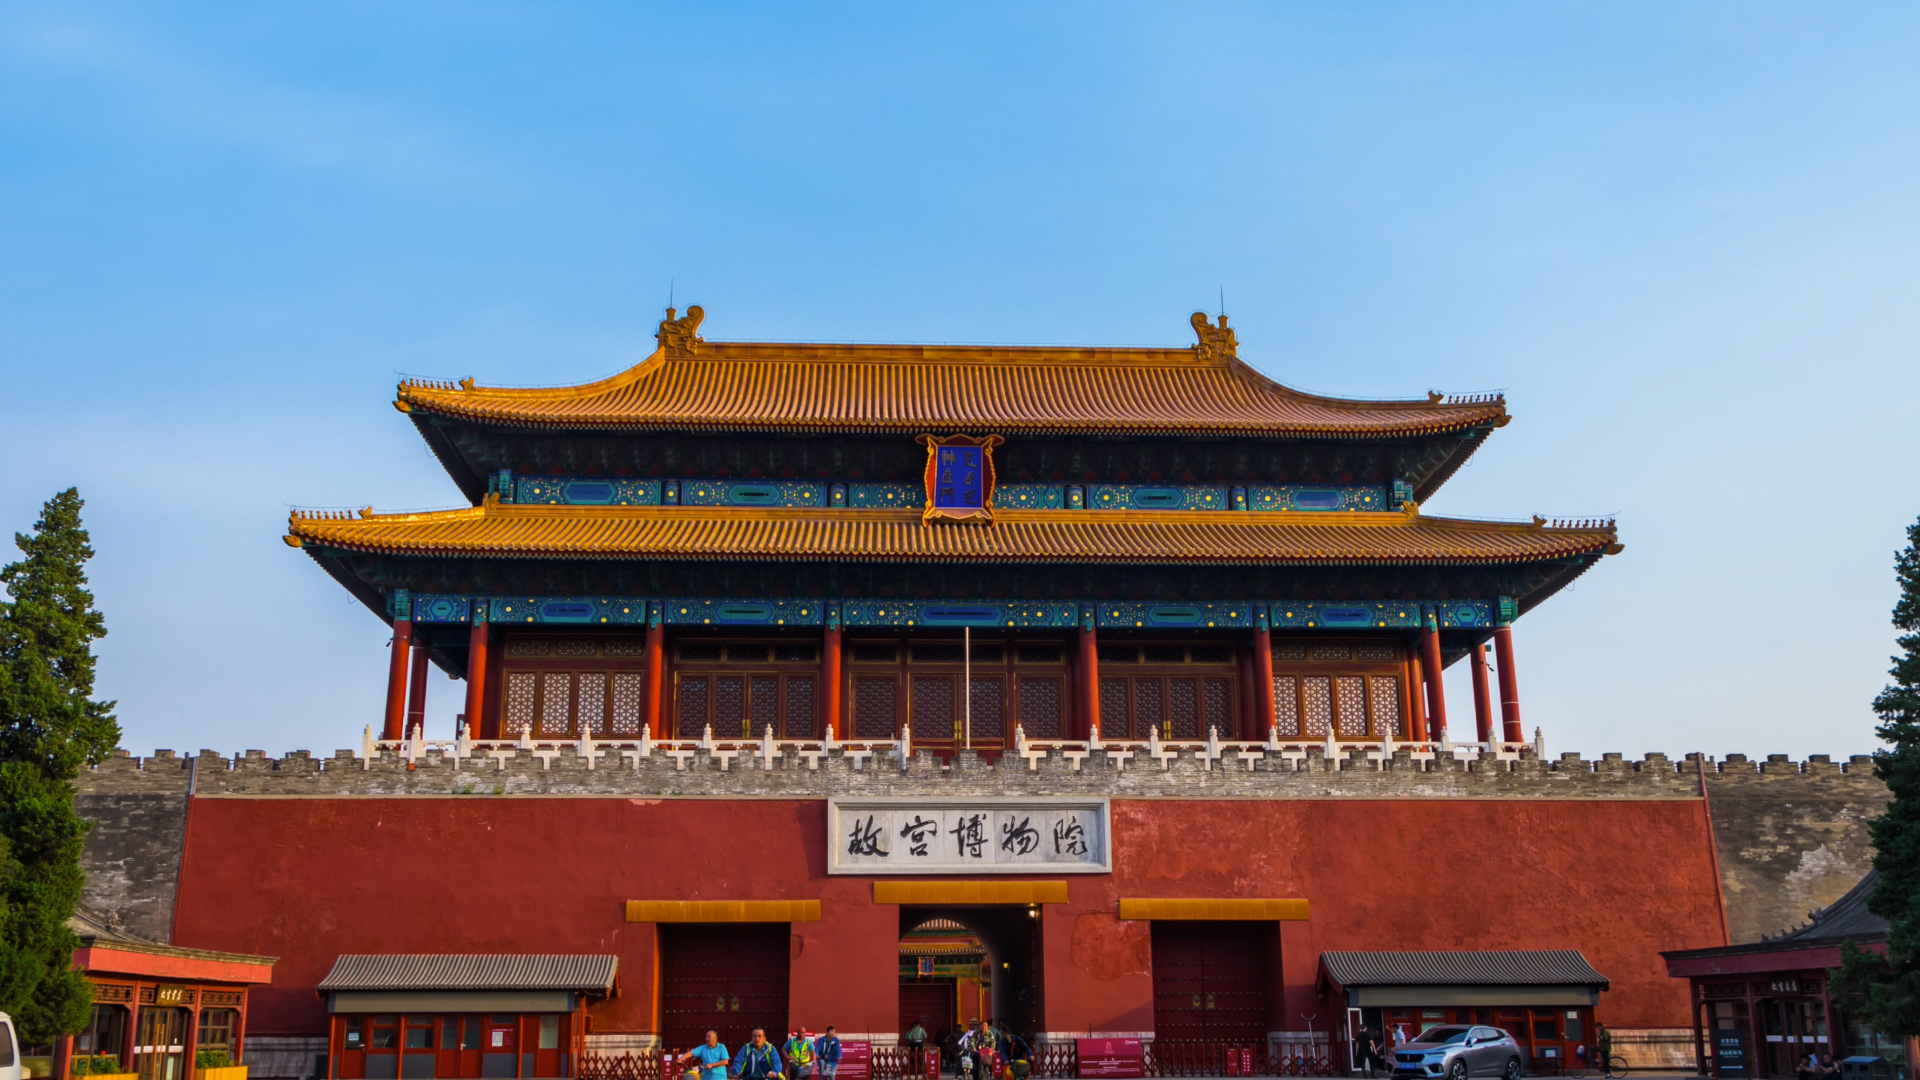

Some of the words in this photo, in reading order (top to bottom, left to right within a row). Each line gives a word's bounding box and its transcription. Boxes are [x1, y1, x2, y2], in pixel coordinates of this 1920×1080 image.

[847, 813, 1089, 859] 故宫博物院
